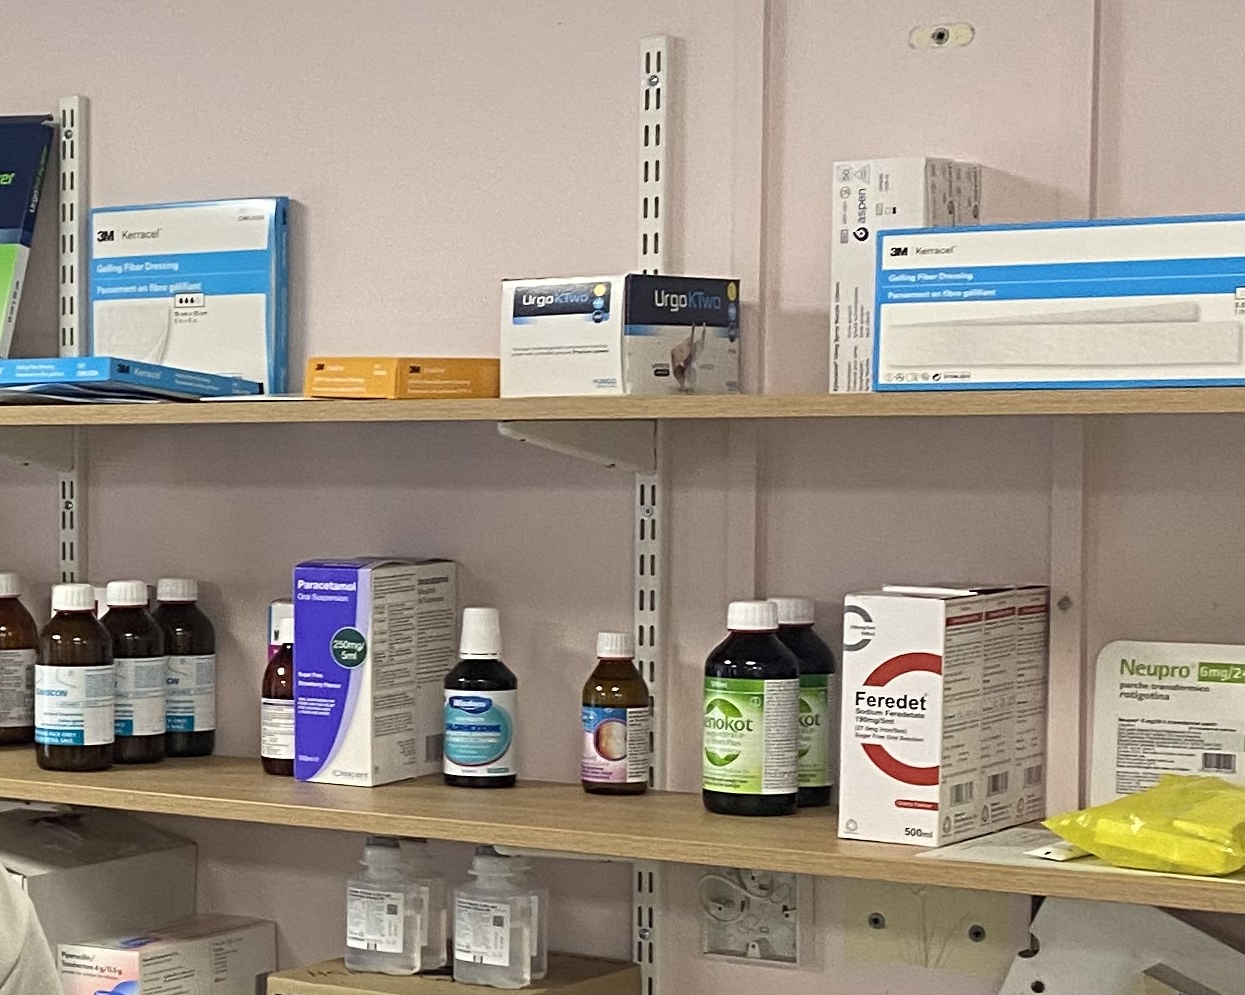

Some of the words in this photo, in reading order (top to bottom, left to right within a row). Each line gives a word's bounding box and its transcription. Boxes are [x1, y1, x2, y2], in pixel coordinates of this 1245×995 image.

[857, 188, 867, 224] aspen
[97, 230, 115, 242] 3M
[890, 247, 909, 257] 3M
[654, 290, 722, 312] UrgoKTwo
[297, 579, 357, 592] Paracetamol
[333, 640, 366, 652] 250mg/
[341, 650, 357, 660] 5ml
[1120, 658, 1190, 680] Neupro
[855, 691, 926, 710] Feredet
[1119, 691, 1170, 701] rotigotina
[705, 715, 753, 731] enokot
[905, 828, 933, 838] 500ml
